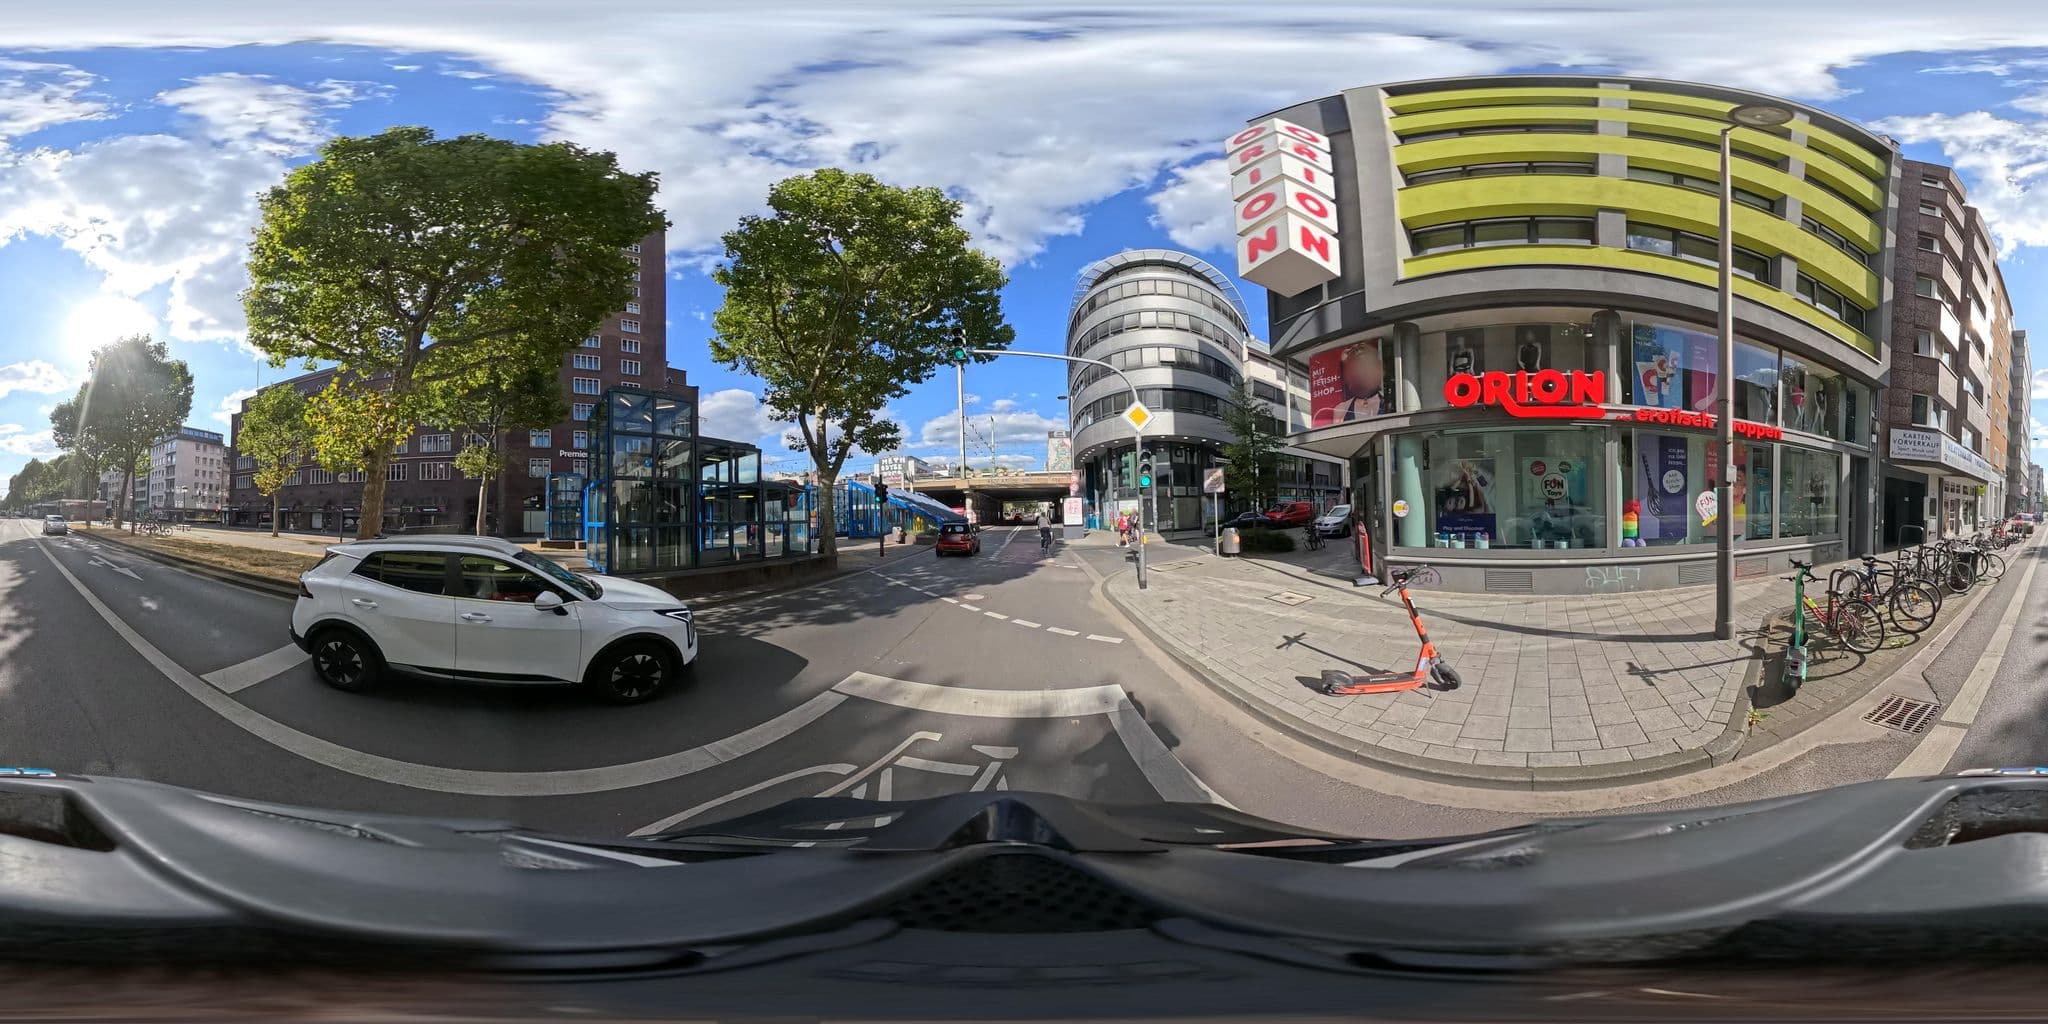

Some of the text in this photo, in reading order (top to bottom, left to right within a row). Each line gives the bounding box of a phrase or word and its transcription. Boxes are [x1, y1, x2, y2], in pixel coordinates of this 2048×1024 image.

[1233, 126, 1277, 263] ORION
[1284, 125, 1329, 262] ORION
[1444, 369, 1606, 418] ORION
[1635, 408, 1713, 428] erotisch
[1893, 438, 1940, 449] VORVERKAUF
[1903, 432, 1931, 441] KARTEN
